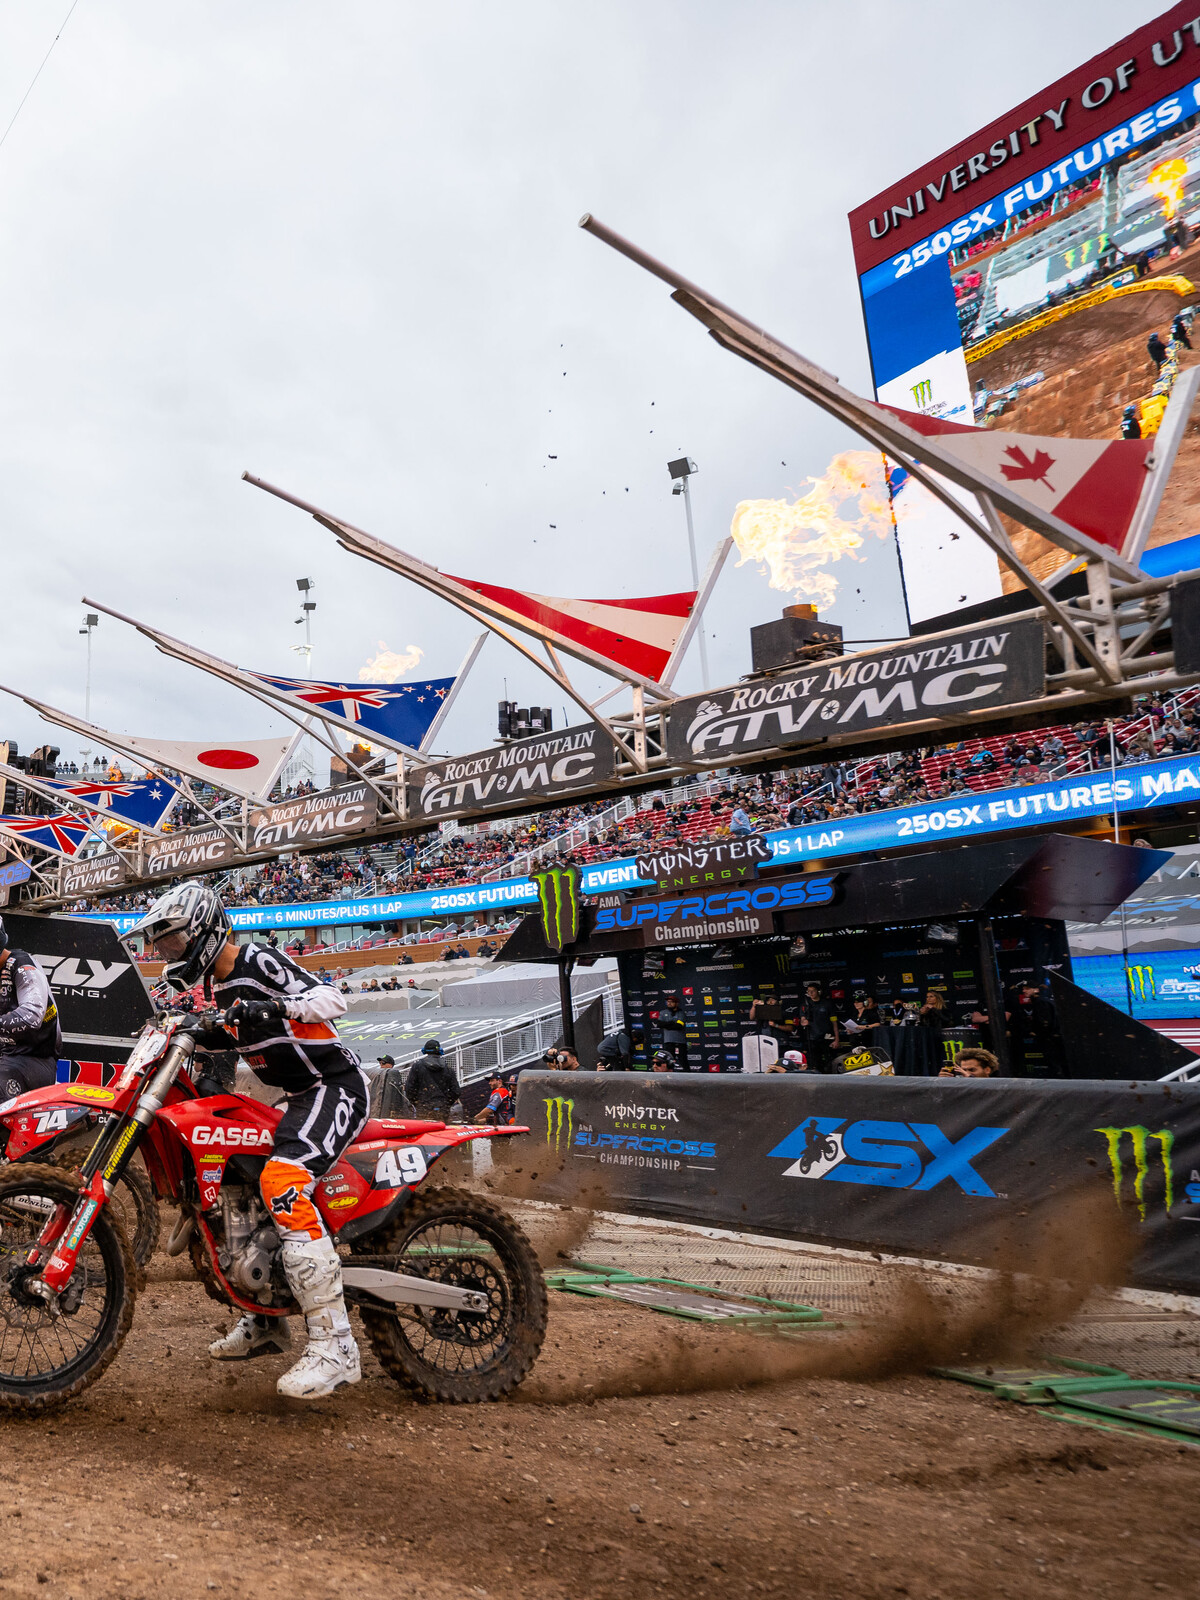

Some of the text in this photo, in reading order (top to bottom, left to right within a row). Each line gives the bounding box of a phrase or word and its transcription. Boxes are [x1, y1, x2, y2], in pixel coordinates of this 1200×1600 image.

[868, 99, 1071, 240] UNIVERSITY
[1081, 58, 1137, 110] OF
[892, 97, 1183, 280] 250SX FUTURES
[727, 632, 1010, 713] ROCKY MOUNTAIN
[837, 663, 1007, 724] MC
[443, 730, 596, 783] ROCKY MOUNTAIN
[506, 752, 596, 794] MC
[270, 788, 367, 823] ROCKY MOUNTAIN
[896, 804, 984, 837] 250SX
[988, 780, 1133, 822] FUTURES
[307, 805, 365, 834] MC
[159, 839, 184, 854] ROCKY
[808, 831, 845, 850] LAP
[73, 853, 120, 877] ROCKY MOUNTAIN
[639, 838, 767, 877] MONSTER
[588, 864, 638, 886] EVENT
[660, 867, 748, 889] ENERGY
[431, 882, 538, 910] 250SX FUTURES
[595, 876, 835, 930] SUPERCROSS
[599, 896, 621, 909] AMA
[231, 912, 264, 927] VENT
[275, 911, 283, 923] 6
[286, 904, 369, 923] MINUTES/PLUS
[380, 902, 402, 914] LAP
[655, 915, 760, 941] Championship
[30, 953, 133, 989] FLY
[50, 985, 101, 999] CING
[68, 1086, 115, 1101] FMF
[33, 1109, 68, 1134] 74
[322, 1087, 357, 1158] FOX
[605, 1103, 680, 1123] MONSTER
[191, 1125, 275, 1147] GASGA
[578, 1124, 593, 1132] AMA
[615, 1121, 667, 1131] ENERGY
[574, 1132, 717, 1157] SUPERCROSS
[375, 1146, 428, 1188] 49
[600, 1152, 681, 1171] CHAMPIONSHIP
[322, 1174, 344, 1183] OGIO
[18, 1197, 52, 1210] DUNLOP
[73, 1202, 96, 1238] MOTOREX
